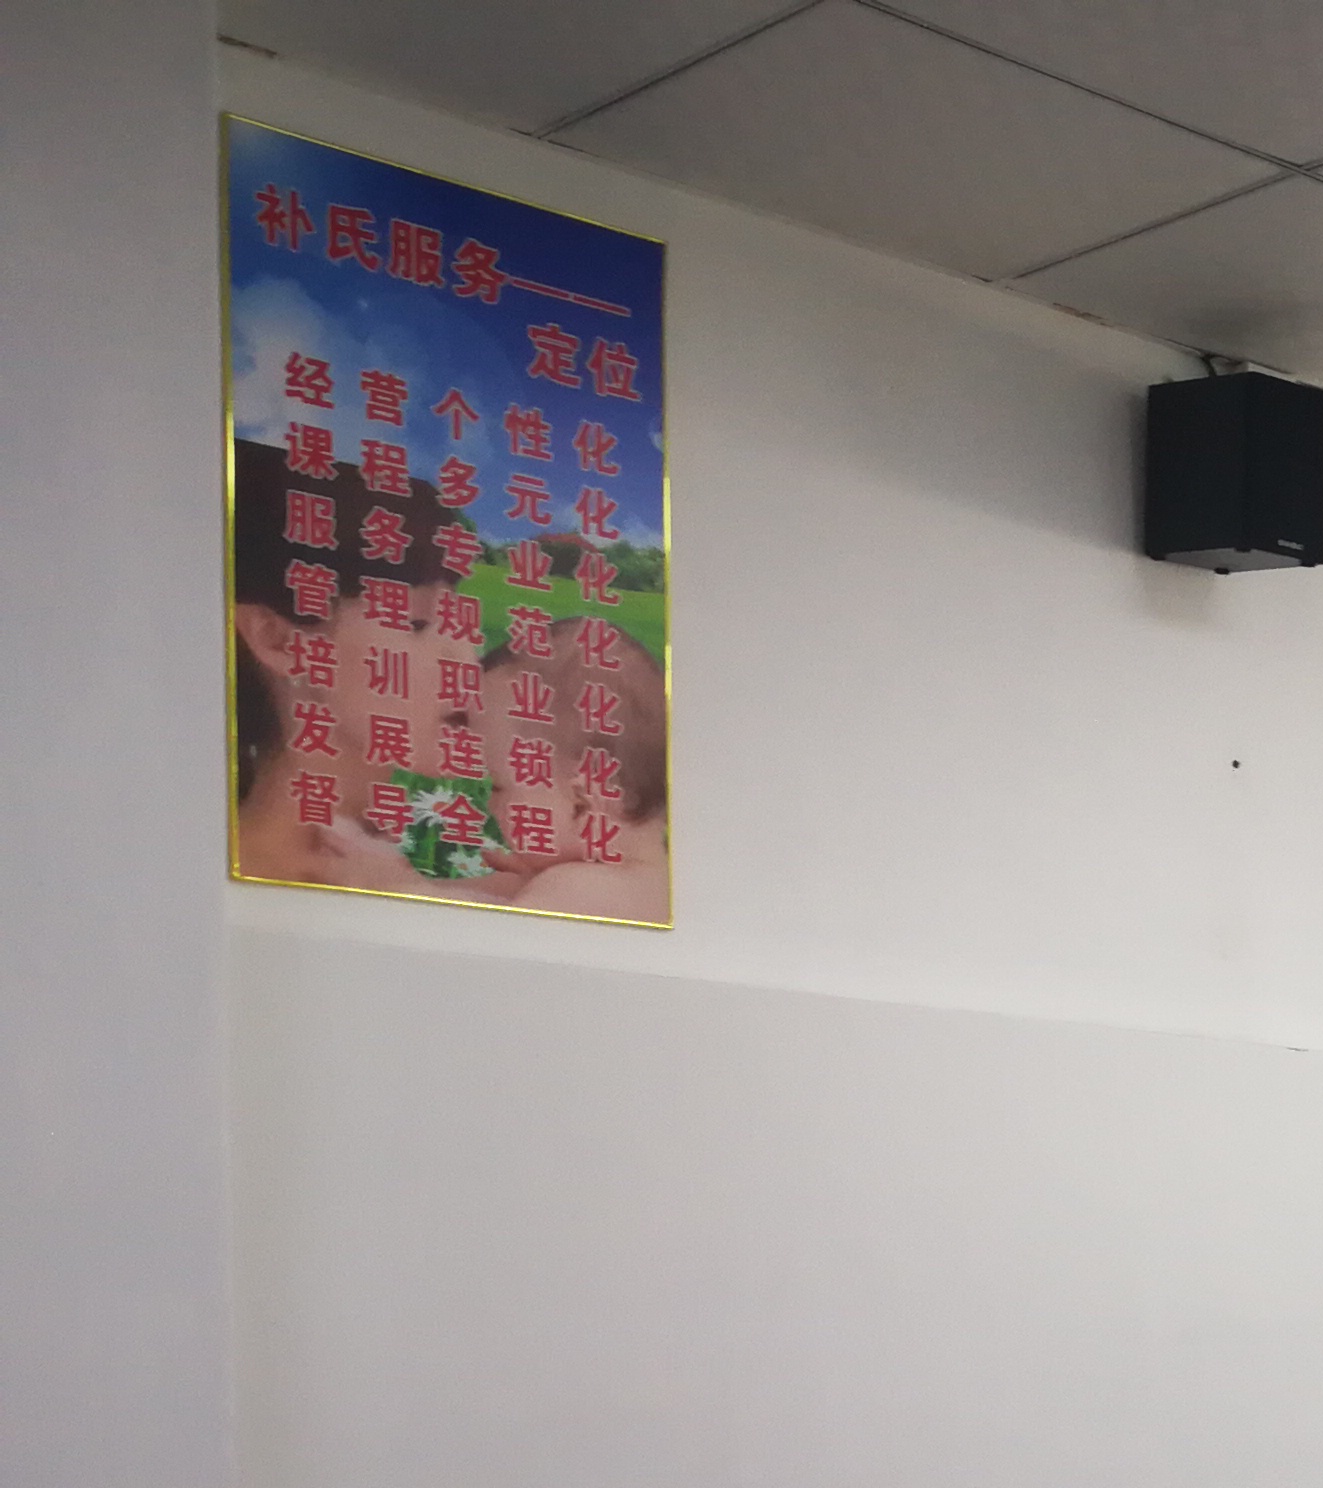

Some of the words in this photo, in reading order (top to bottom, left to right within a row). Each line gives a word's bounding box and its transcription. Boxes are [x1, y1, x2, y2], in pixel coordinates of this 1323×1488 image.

[284, 351, 621, 476] 经营个性化
[527, 323, 641, 401] 定位
[284, 421, 621, 541] 课程多元化
[283, 489, 623, 606] 服务专业化
[284, 558, 623, 670] 管理规范化
[286, 629, 625, 736] 培训职业化
[289, 701, 624, 801] 发展连锁化
[289, 769, 624, 863] 督导全程化
